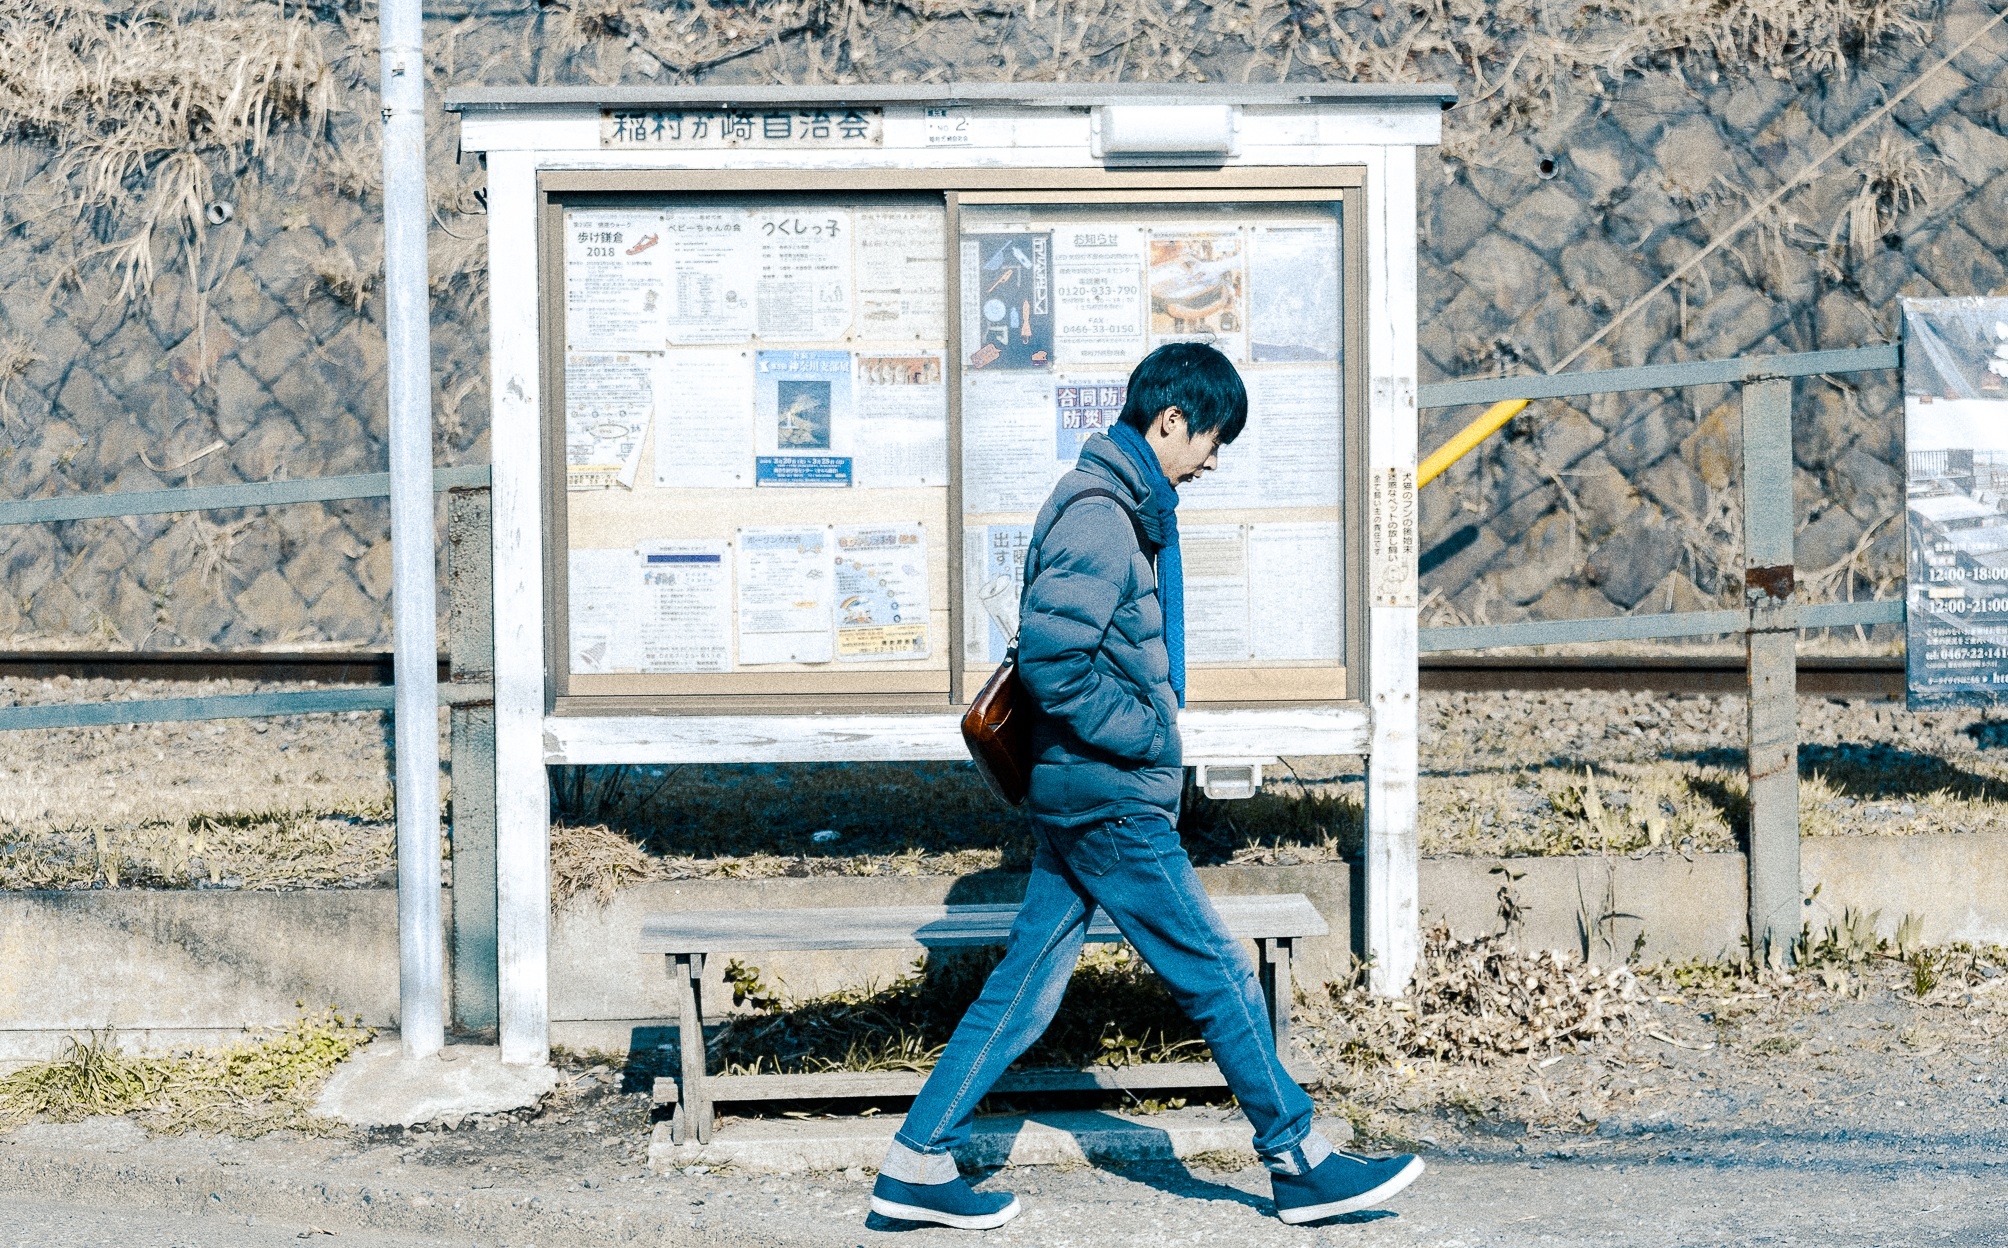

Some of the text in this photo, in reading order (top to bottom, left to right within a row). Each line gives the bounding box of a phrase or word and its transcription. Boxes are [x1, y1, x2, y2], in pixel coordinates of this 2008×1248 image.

[762, 218, 841, 237] つくしっ子
[578, 232, 623, 243] 歩け鎌倉
[1074, 234, 1118, 245] お知らせ
[587, 247, 615, 257] 2018
[1059, 286, 1137, 296] 0120-933-790
[1063, 325, 1134, 334] 0466-33-0150
[1929, 567, 2008, 581] 12:00-18:00
[1930, 598, 2008, 613] 12:00-21:00
